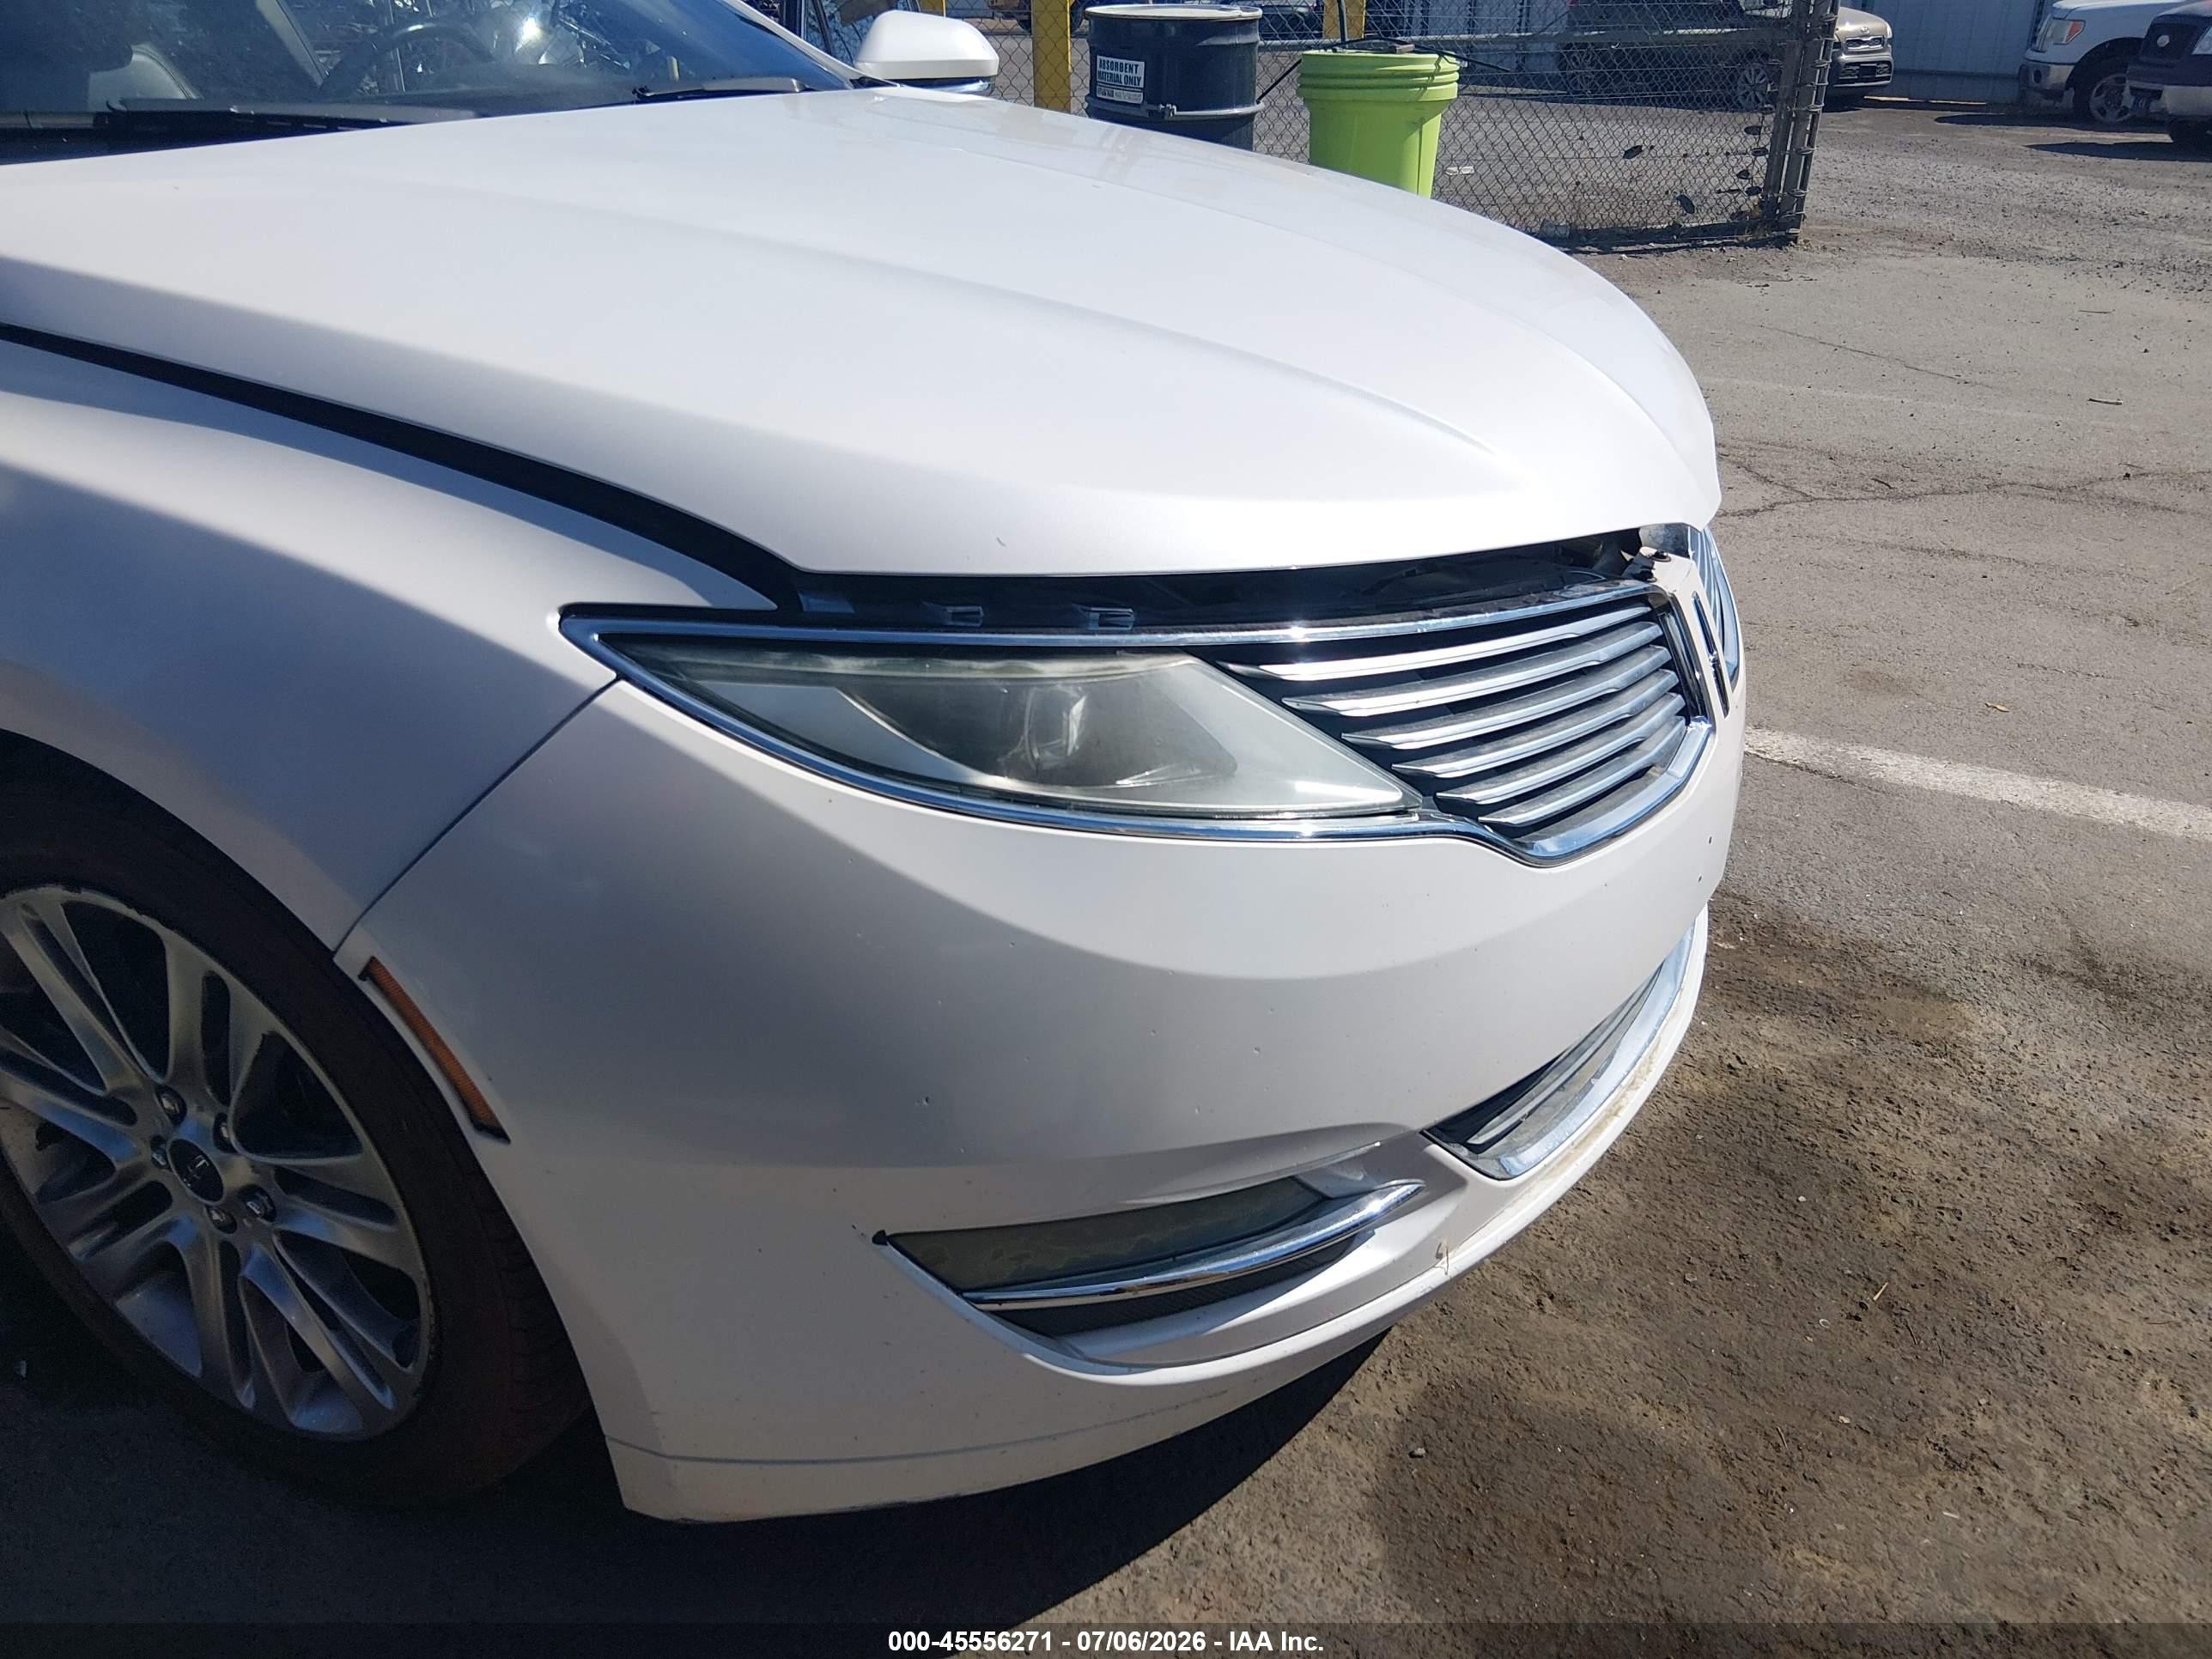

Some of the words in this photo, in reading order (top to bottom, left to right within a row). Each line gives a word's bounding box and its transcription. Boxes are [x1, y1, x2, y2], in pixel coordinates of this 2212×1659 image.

[1099, 58, 1139, 75] ABSORBENT
[1097, 70, 1123, 84] MATERIAL
[1124, 75, 1142, 87] ONLY
